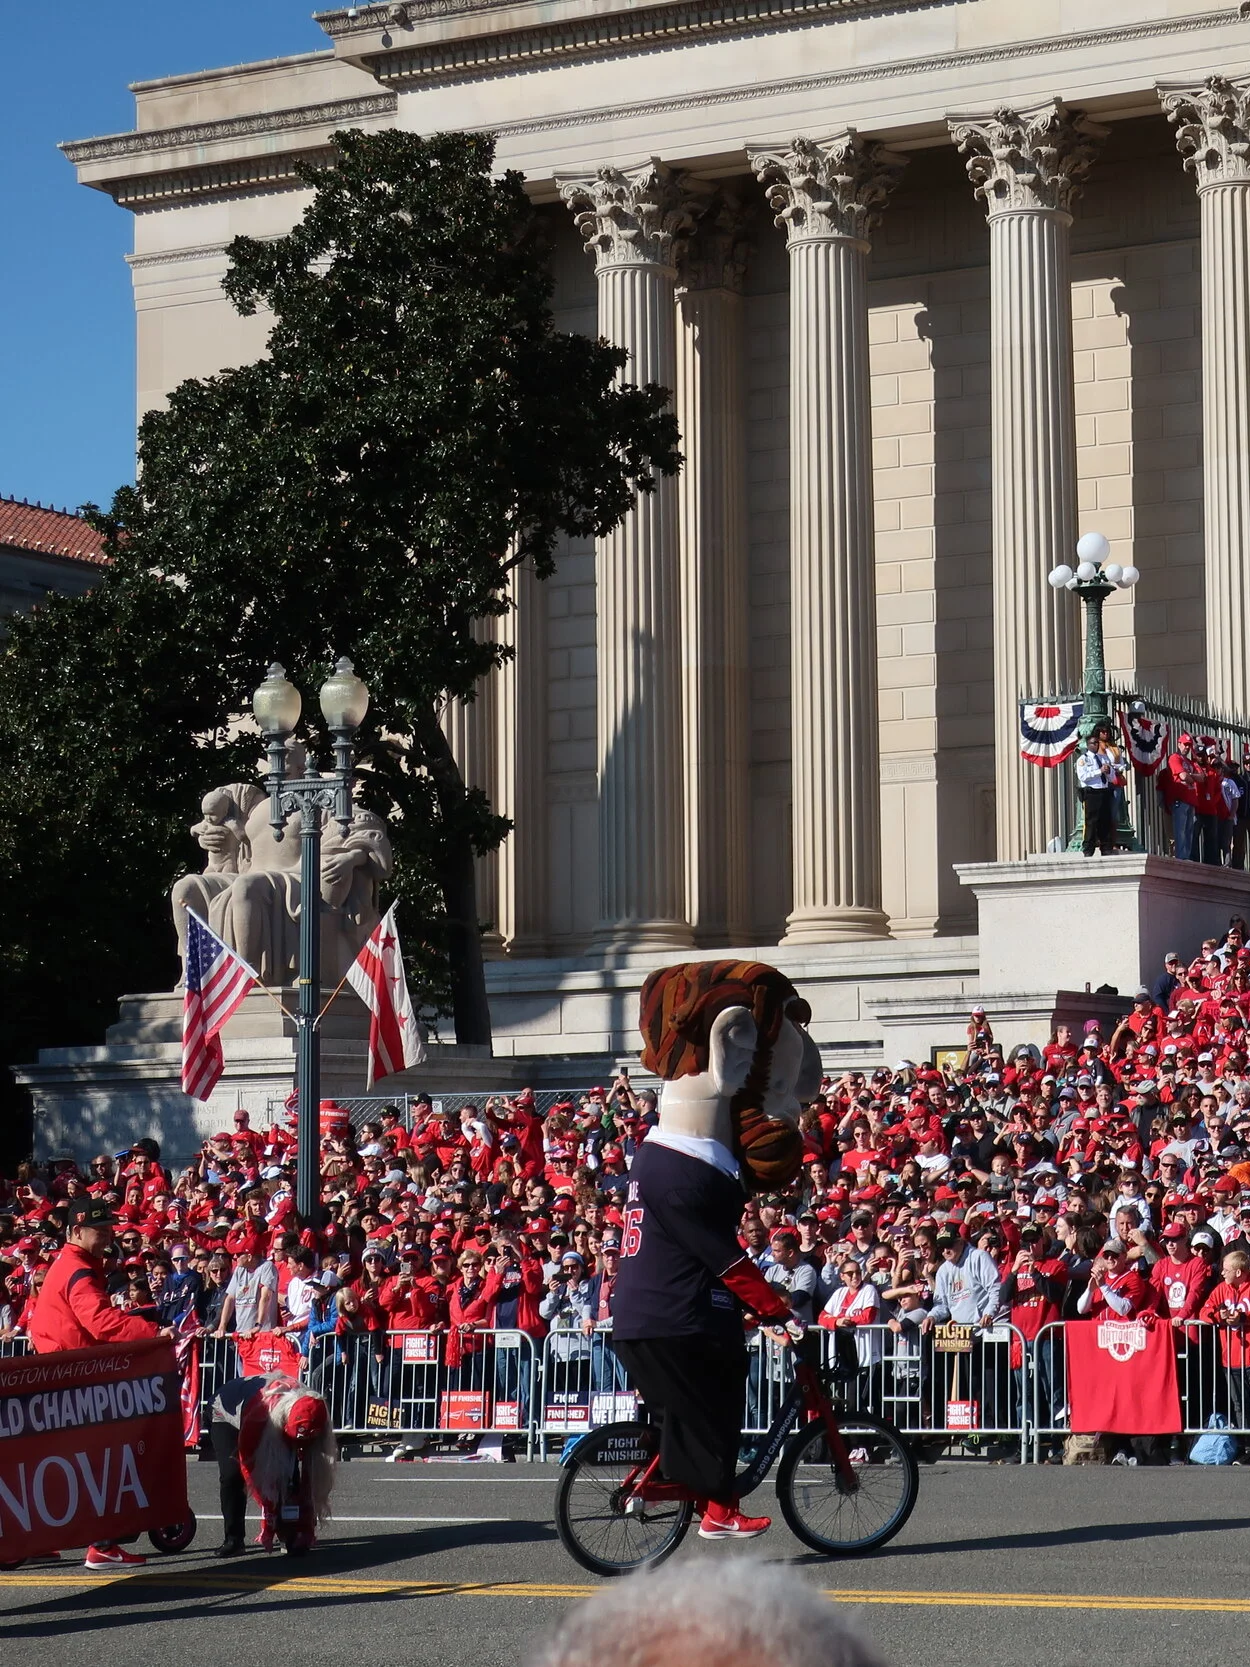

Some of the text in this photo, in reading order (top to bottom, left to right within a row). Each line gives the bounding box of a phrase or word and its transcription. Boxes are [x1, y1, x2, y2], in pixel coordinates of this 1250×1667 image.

[52, 1353, 134, 1381] NATIONALS
[28, 1375, 167, 1432] CHAMPIONS
[607, 1436, 641, 1450] FIGHT
[767, 1407, 797, 1455] CHAMPIONS
[597, 1449, 651, 1462] FINISHED.
